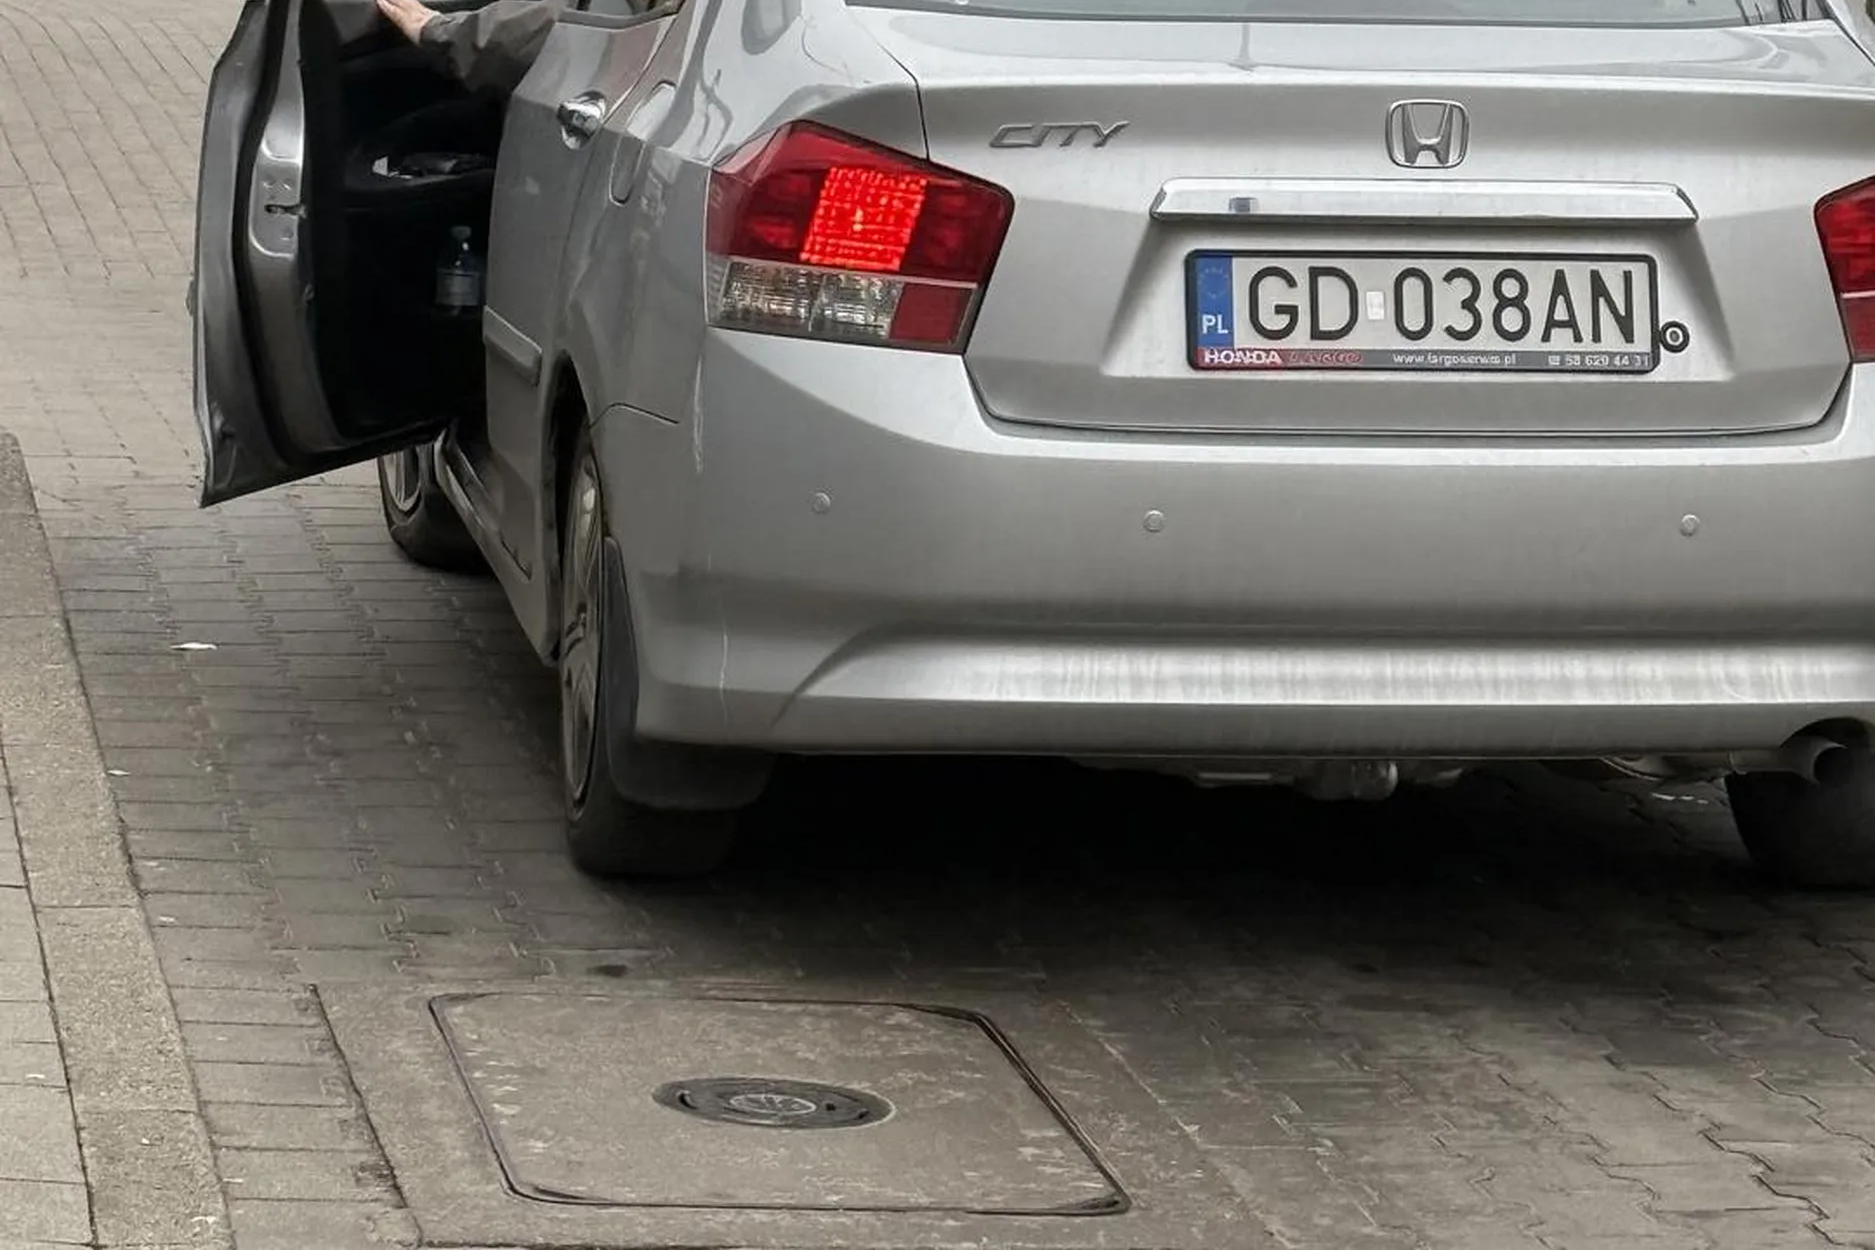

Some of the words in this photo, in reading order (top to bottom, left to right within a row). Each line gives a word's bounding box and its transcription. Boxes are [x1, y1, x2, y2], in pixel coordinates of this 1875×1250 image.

[989, 120, 1130, 148] CITY
[1249, 266, 1358, 340] GD
[1394, 267, 1635, 343] 038AN
[1202, 314, 1229, 334] PL
[1204, 350, 1282, 364] HONDA
